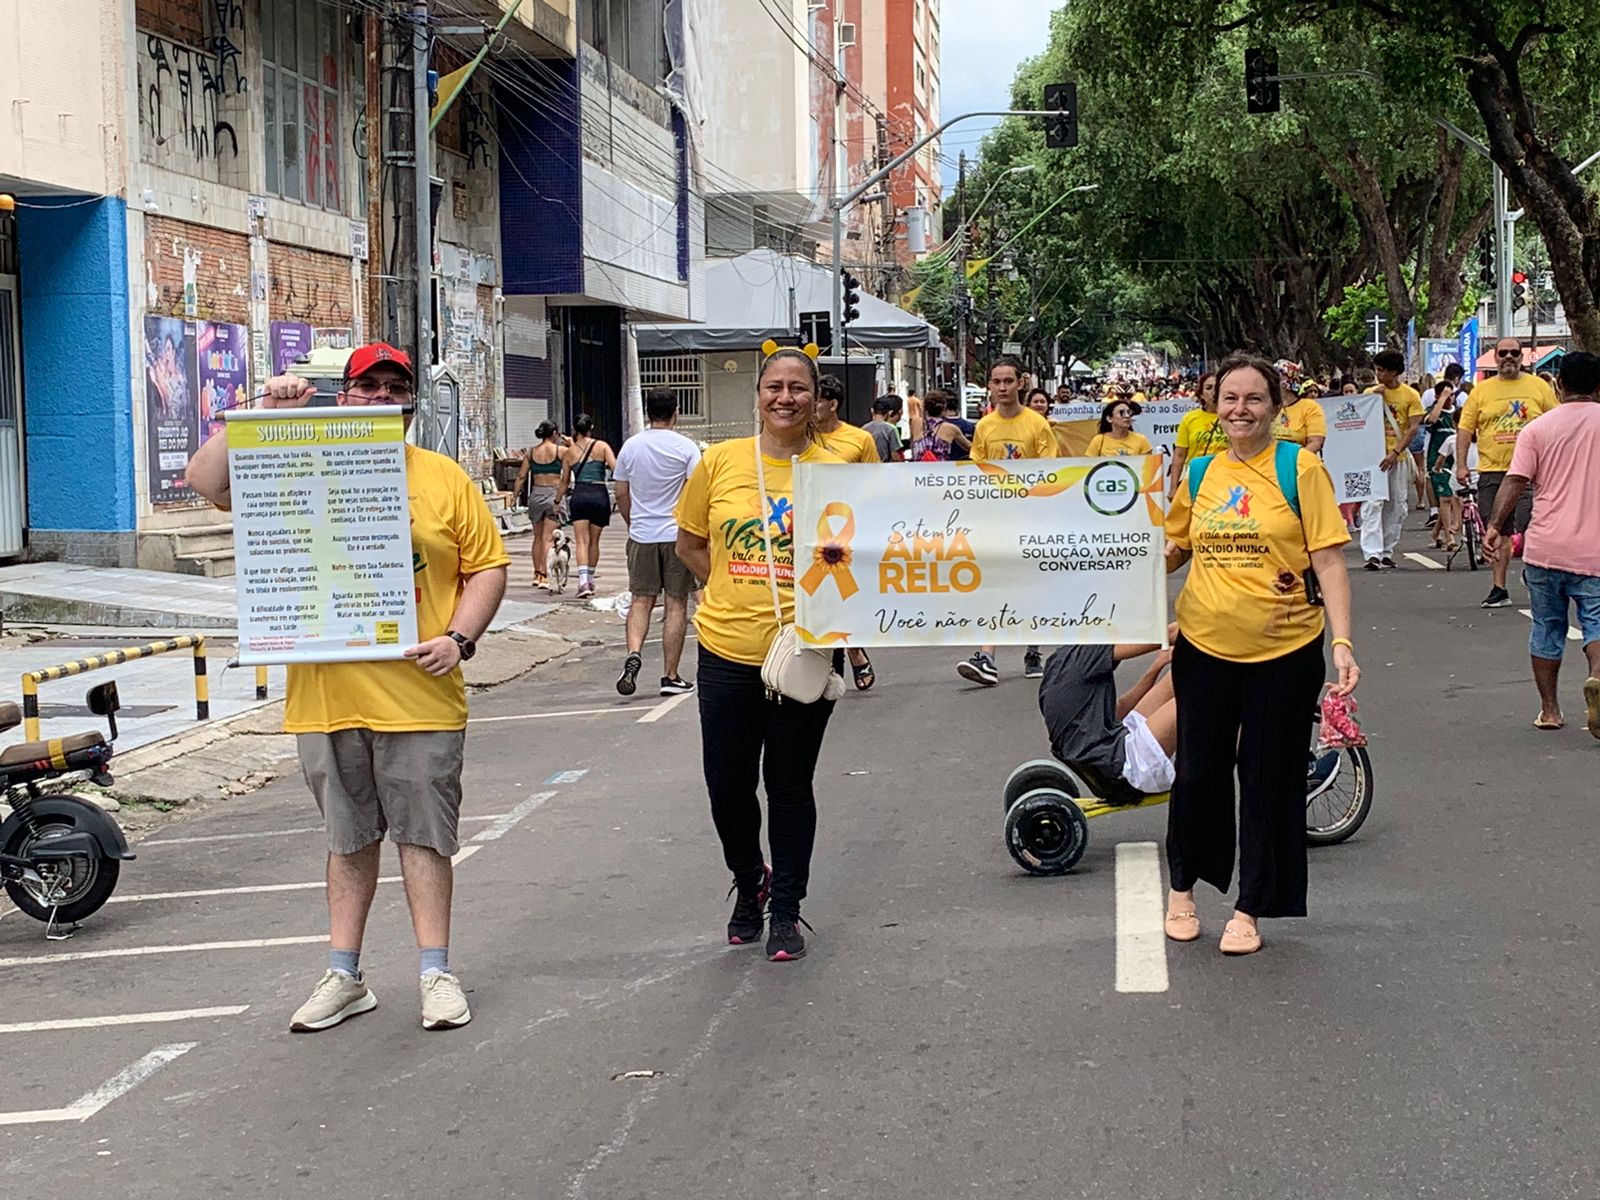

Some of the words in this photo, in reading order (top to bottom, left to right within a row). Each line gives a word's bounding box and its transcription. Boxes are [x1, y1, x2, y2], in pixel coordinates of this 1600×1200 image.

[1159, 406, 1170, 414] ao
[256, 422, 320, 443] SUICÍDIO,
[325, 421, 374, 440] NUNCA!
[914, 474, 944, 486] MÊS
[947, 475, 966, 486] DE
[970, 472, 1057, 486] PREVENÇÃO
[1096, 479, 1127, 492] cas
[943, 489, 965, 500] AO
[967, 487, 1029, 500] SUICÍDIO
[241, 511, 268, 519] esperança
[888, 509, 972, 544] Setembro
[720, 518, 794, 552] Vive
[1019, 534, 1065, 545] FALAR
[1068, 531, 1076, 544] É
[1078, 534, 1089, 544] A
[1091, 533, 1151, 544] MELHOR
[1223, 532, 1230, 540] a
[1230, 531, 1259, 543] pena
[882, 529, 977, 561] AMA
[1235, 544, 1271, 554] NUNCA
[732, 549, 755, 562] vale
[758, 554, 767, 563] a
[1022, 546, 1093, 560] SOLUÇÃO,
[1095, 546, 1148, 558] VAMOS
[1038, 560, 1132, 572] CONVERSAR?
[878, 561, 982, 593] RELO
[332, 592, 353, 600] Aguarda
[875, 608, 927, 634] Você
[935, 611, 972, 629] não
[976, 603, 1025, 630] está
[1029, 593, 1116, 630] sozinho!
